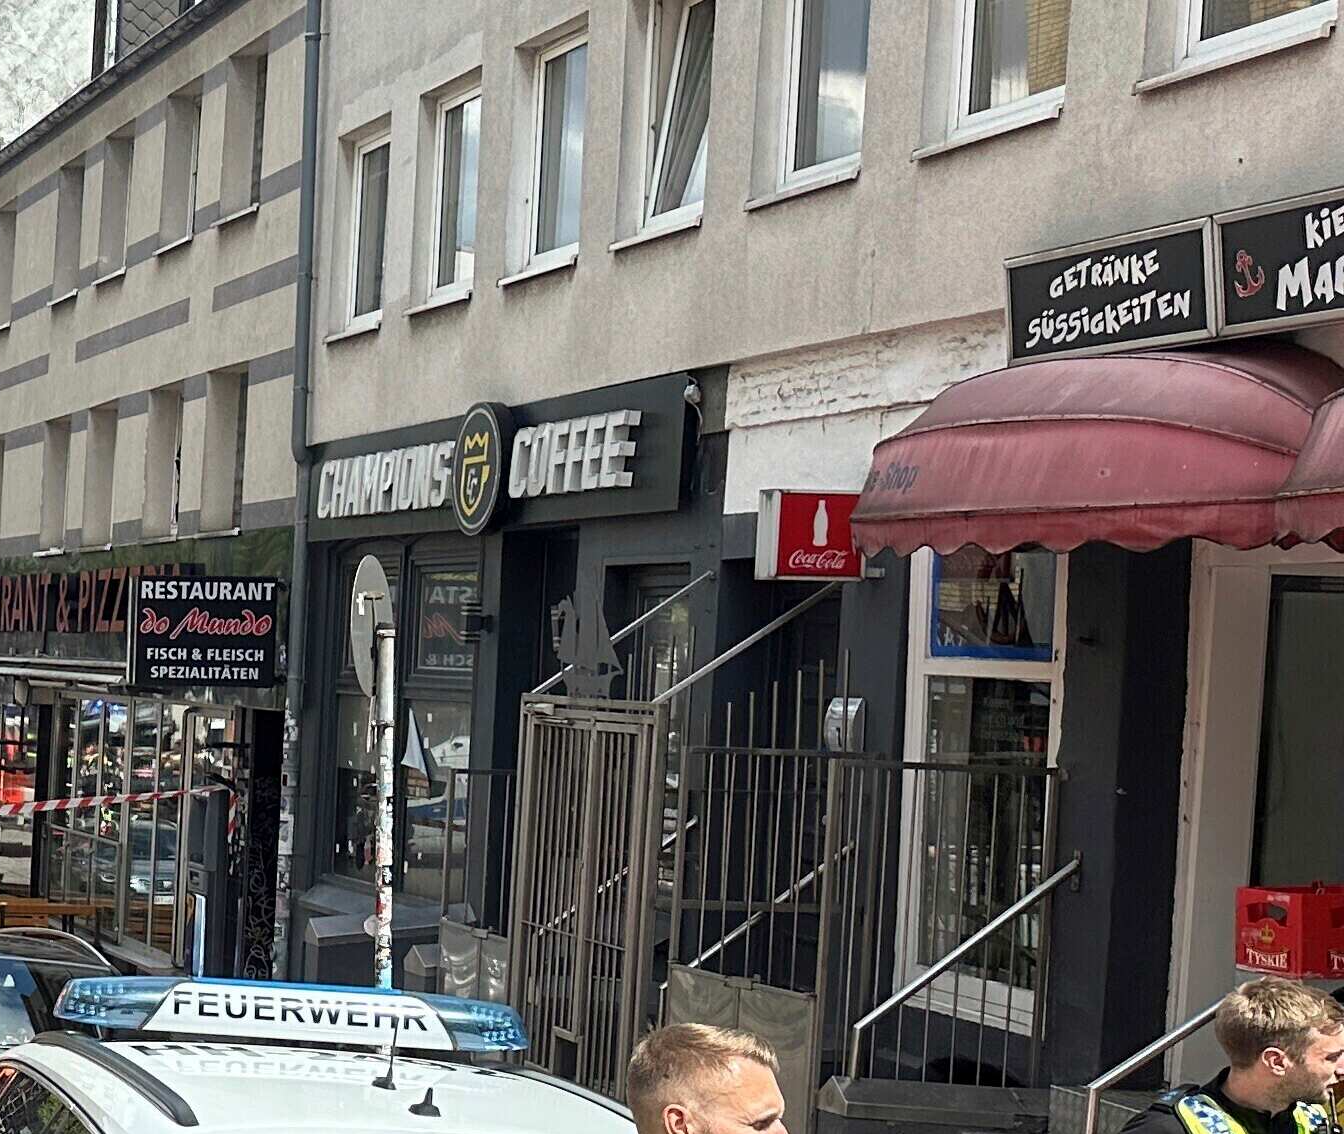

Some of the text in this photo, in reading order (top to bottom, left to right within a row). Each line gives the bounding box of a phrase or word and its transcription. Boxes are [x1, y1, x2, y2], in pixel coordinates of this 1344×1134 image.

[1050, 248, 1160, 298] GETRÄNKE
[317, 410, 642, 519] CHAMPIONS COFFEE
[55, 574, 71, 634] &
[140, 580, 276, 601] RESTAURANT
[139, 607, 272, 640] do Mundo
[146, 647, 265, 662] FISCH & FLEISCH
[150, 664, 260, 681] SPEZIALITÄTEN
[1245, 947, 1288, 969] TYSKIE
[173, 989, 427, 1032] FEUERWEHR
